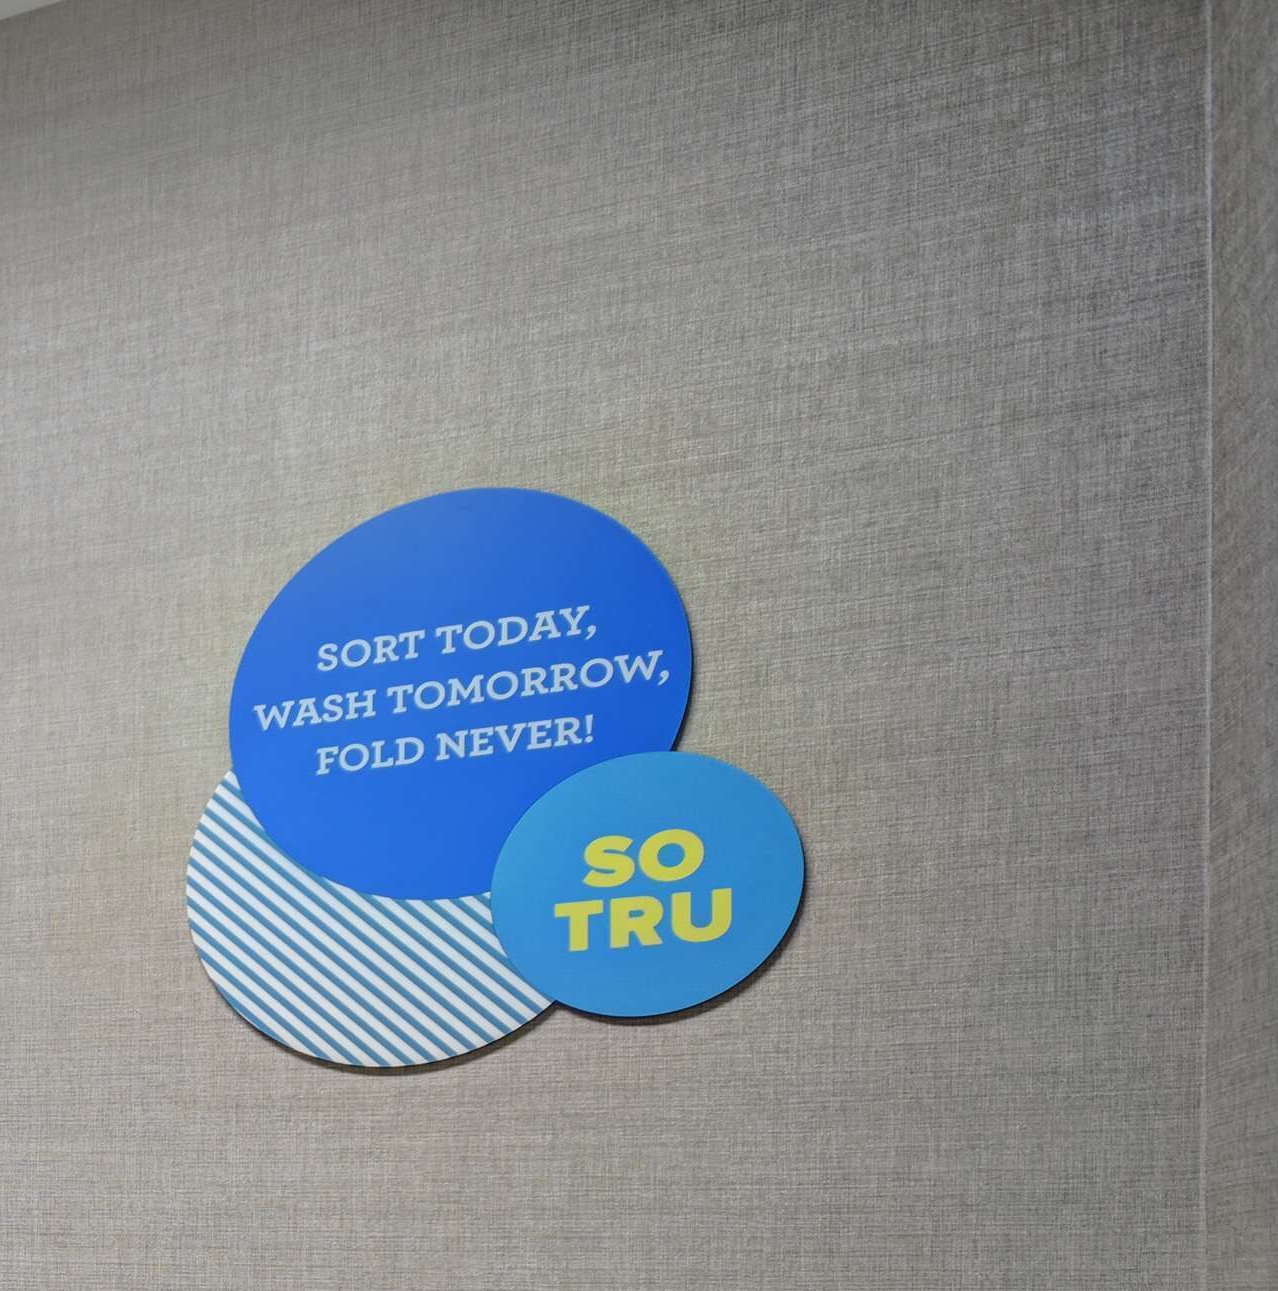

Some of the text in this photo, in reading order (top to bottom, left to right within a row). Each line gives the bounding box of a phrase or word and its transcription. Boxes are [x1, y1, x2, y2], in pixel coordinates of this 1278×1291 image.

[316, 604, 597, 672] SORT TODAY,
[254, 649, 670, 732] WASH TOMORROW,
[316, 714, 595, 776] FOLD NEVER!
[582, 828, 705, 888] SO
[554, 887, 732, 952] TRU
